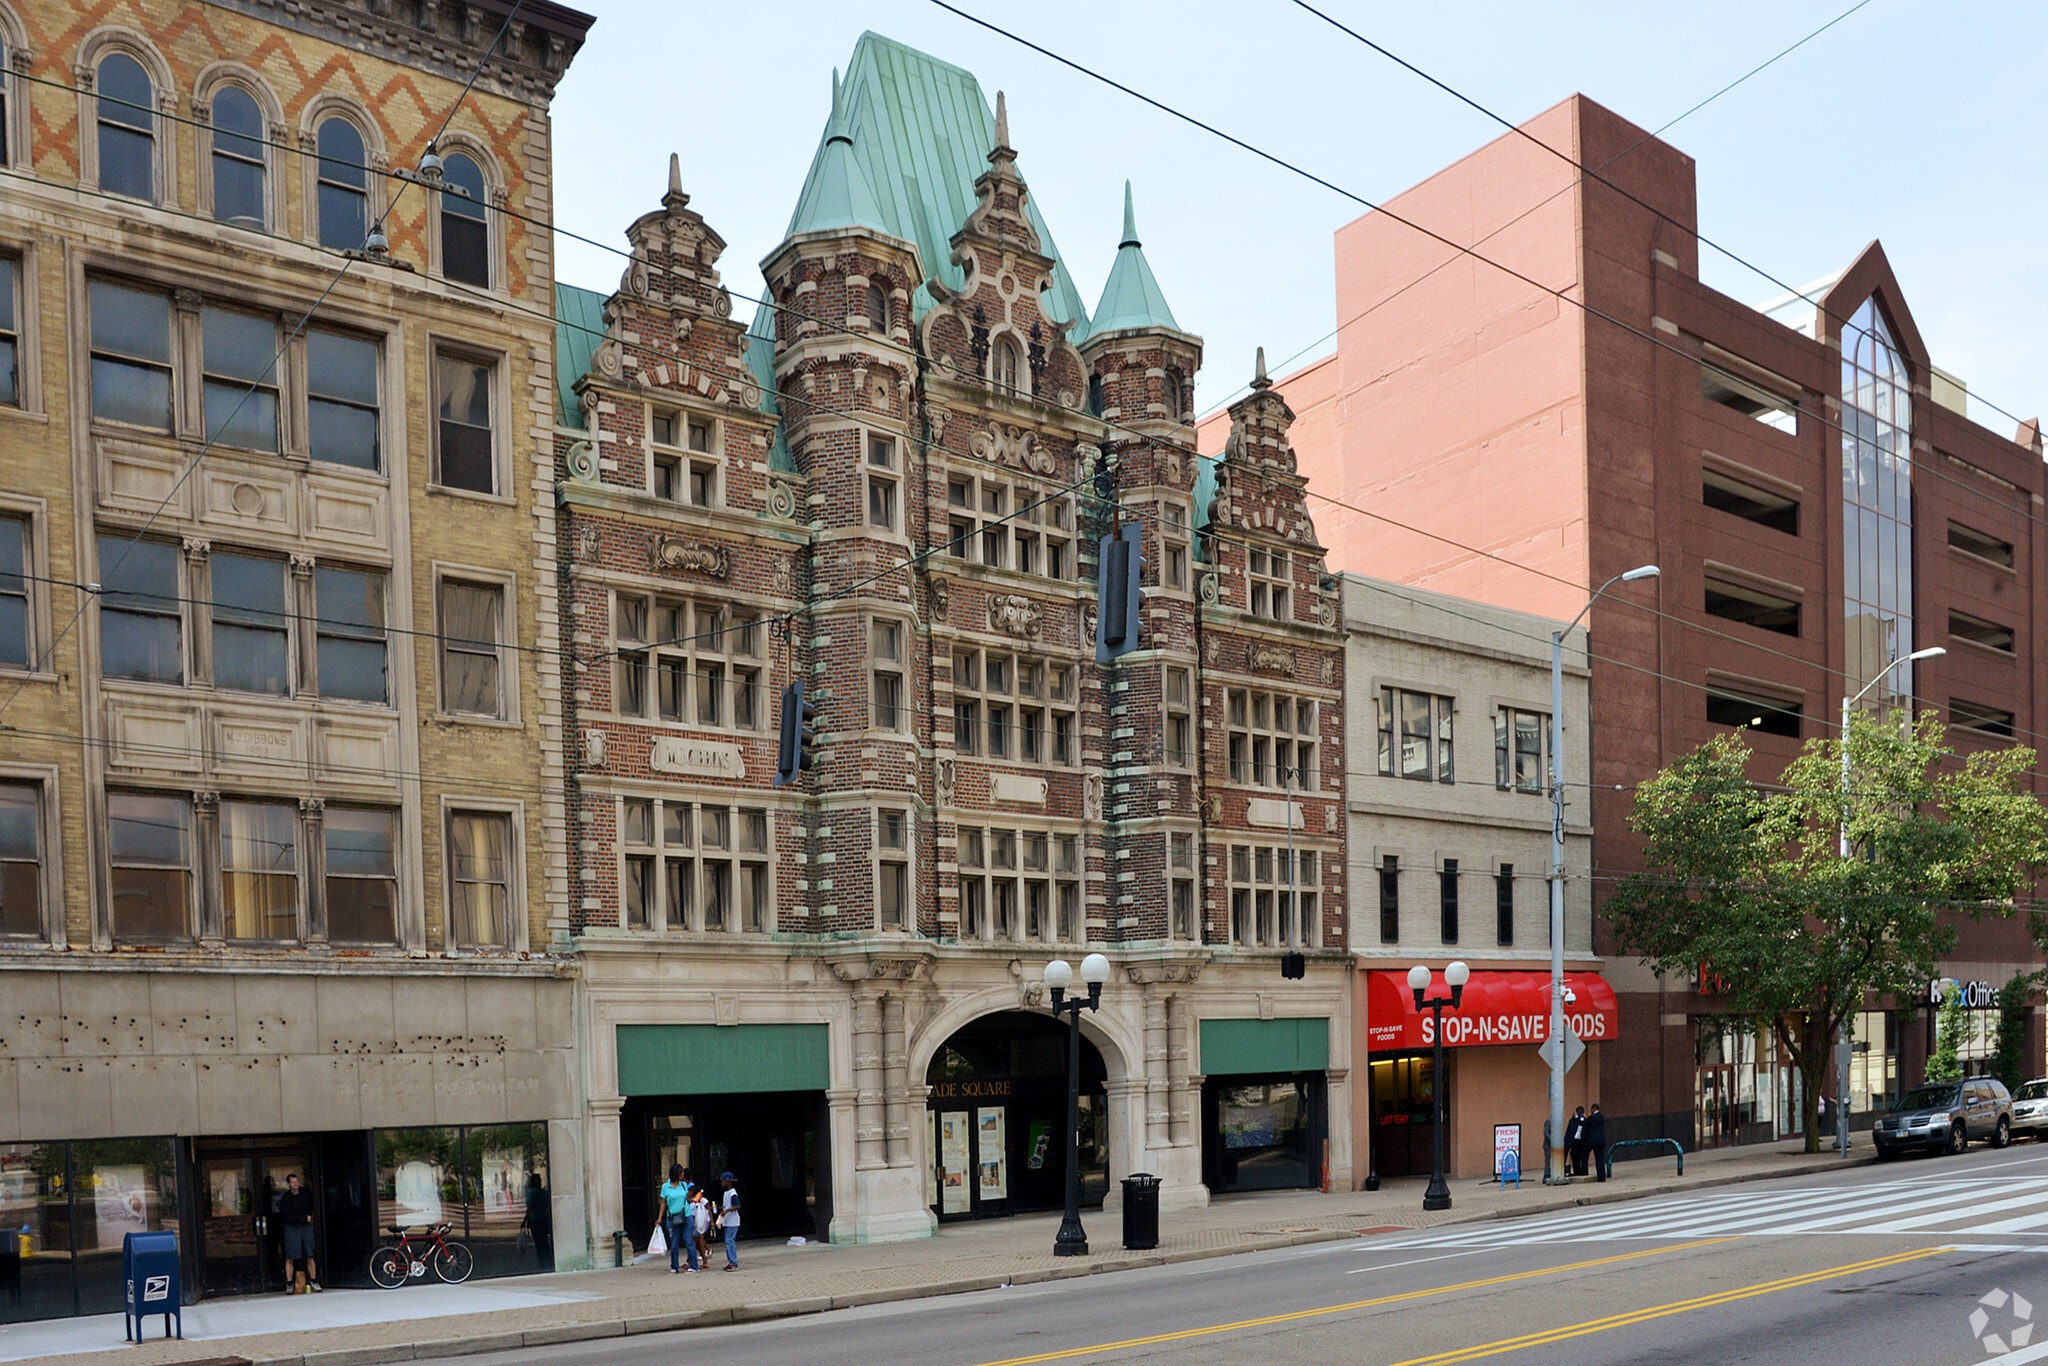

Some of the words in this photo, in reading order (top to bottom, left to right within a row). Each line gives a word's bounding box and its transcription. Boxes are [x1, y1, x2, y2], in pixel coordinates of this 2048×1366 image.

[1369, 1024, 1403, 1035] STOP-N-SAVE
[1422, 1014, 1544, 1043] STOP-N-SAVE
[1549, 1013, 1605, 1039] ODS
[1377, 1033, 1395, 1041] FOODS
[928, 1083, 957, 1098] ADE
[961, 1081, 1010, 1098] SQUARE
[1380, 1114, 1409, 1126] LOTTERY
